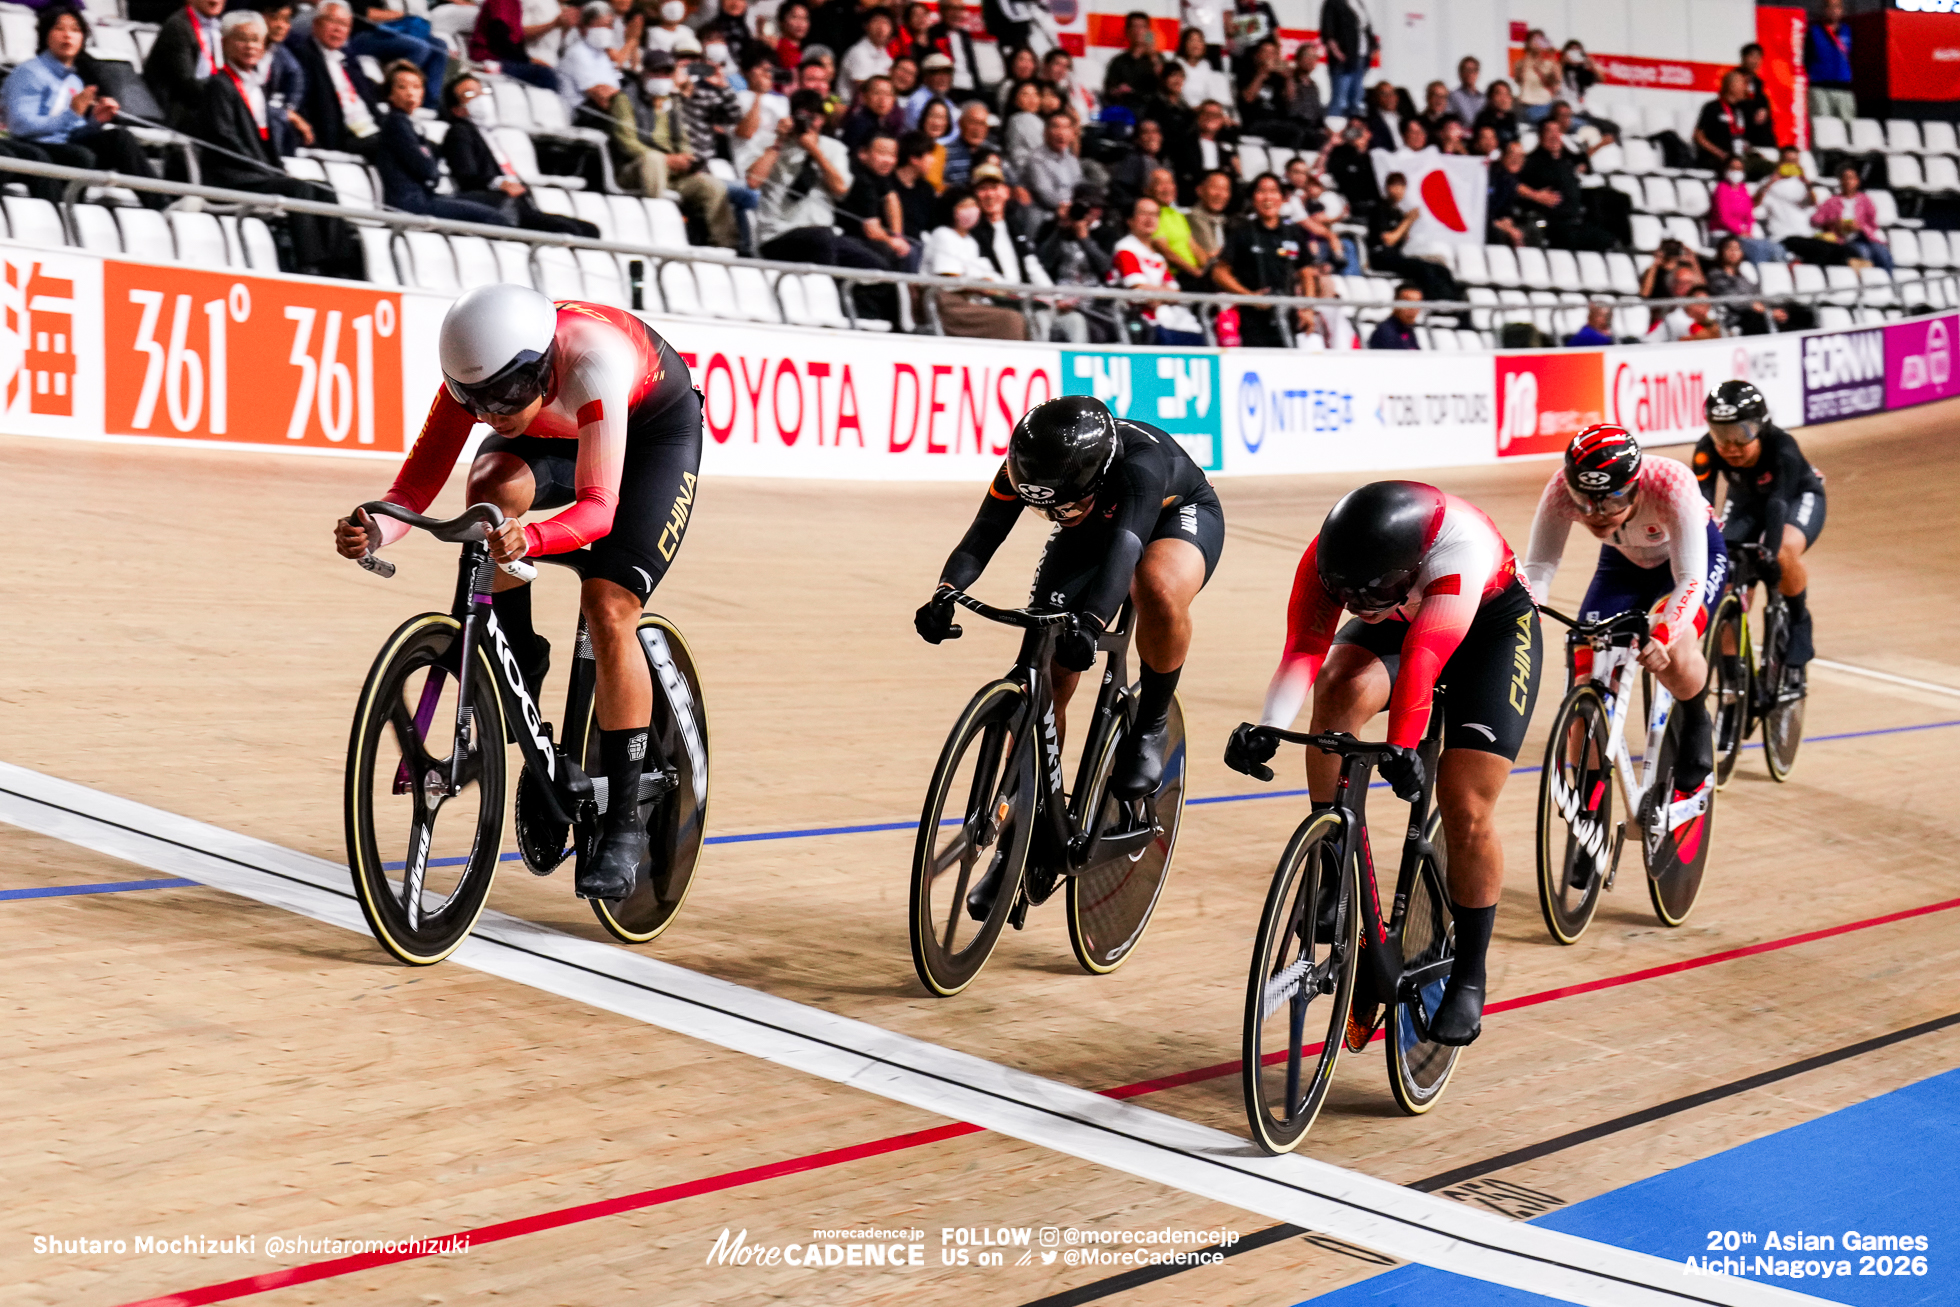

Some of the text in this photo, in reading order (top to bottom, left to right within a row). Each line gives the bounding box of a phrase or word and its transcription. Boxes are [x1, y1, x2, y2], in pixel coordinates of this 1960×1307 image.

[129, 283, 251, 434] 361°
[284, 300, 396, 444] 361°
[1613, 362, 1706, 434] Canon
[656, 471, 697, 562] CHINA
[1673, 578, 1699, 622] JAPAN
[1705, 553, 1727, 604] JAPAN
[486, 608, 556, 782] KOGA
[1509, 610, 1533, 716] CHINA
